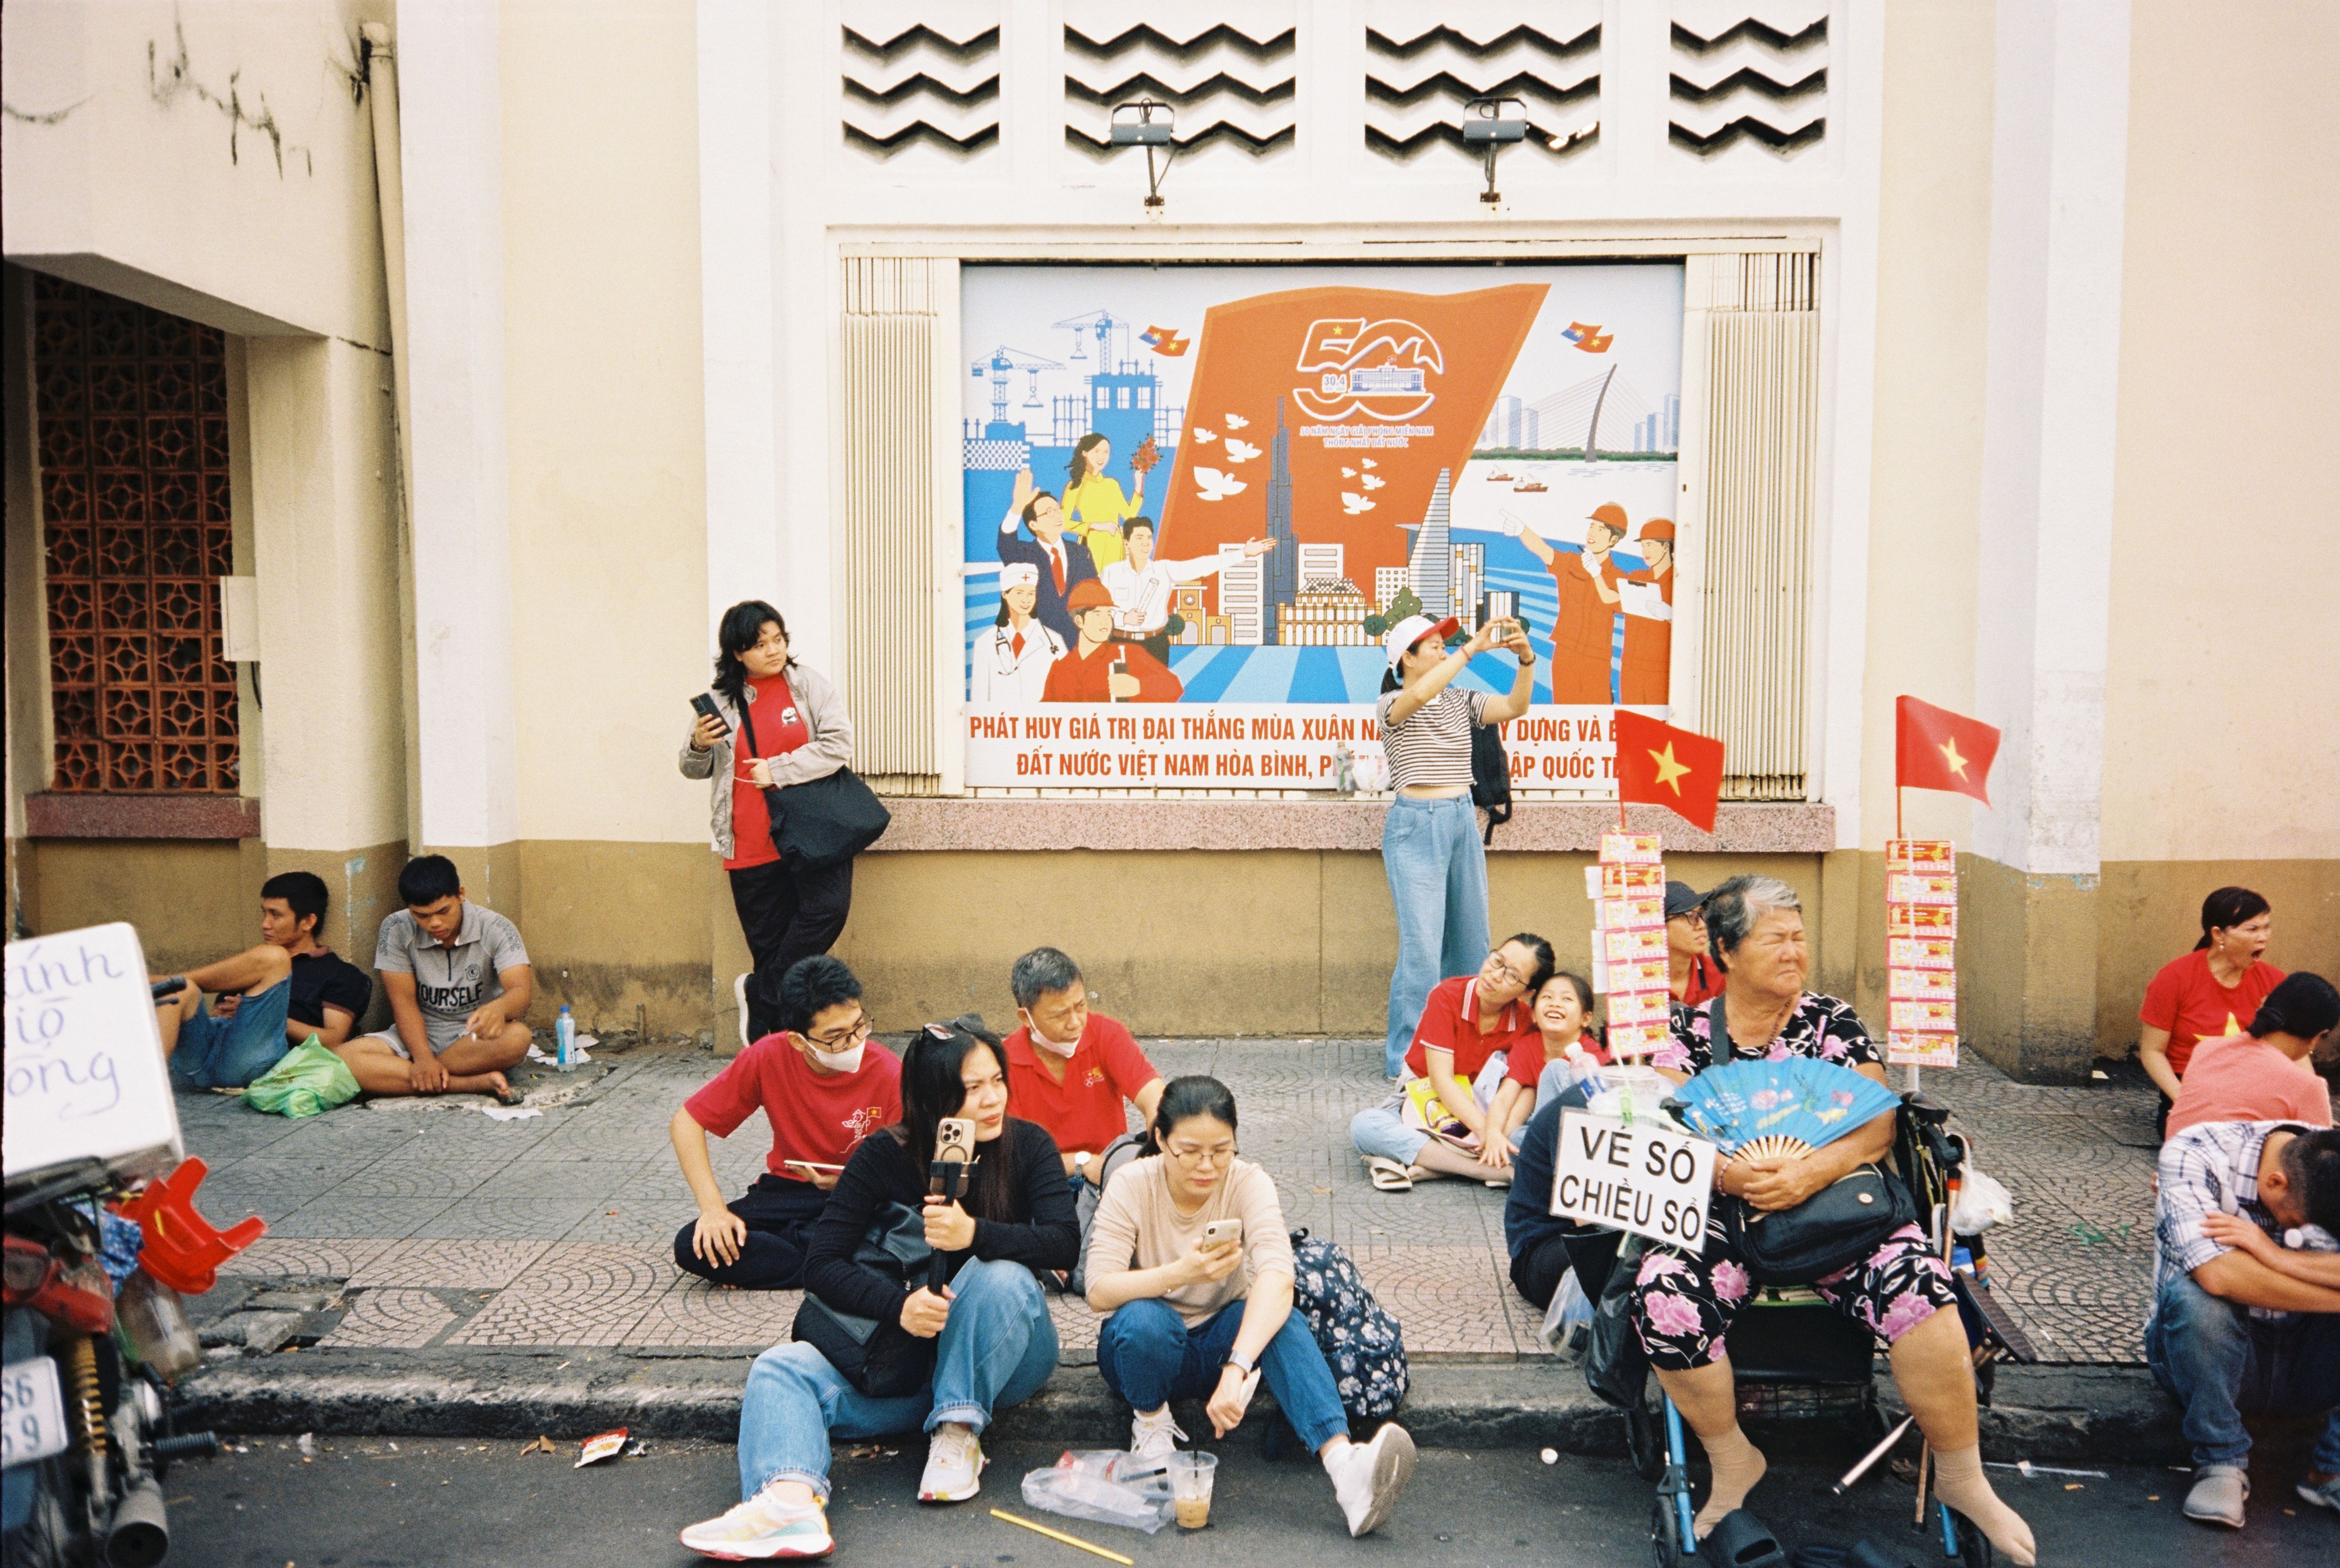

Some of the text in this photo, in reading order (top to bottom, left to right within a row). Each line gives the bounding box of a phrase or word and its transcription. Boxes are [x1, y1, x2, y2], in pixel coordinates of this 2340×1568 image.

[1323, 376, 1345, 386] 30.4
[1415, 426, 1433, 435] NAM
[970, 712, 1019, 738] PHÁT
[1026, 717, 1062, 739] HUY
[1069, 712, 1101, 739] GIÁ
[1107, 718, 1136, 744] TRỊ
[1143, 718, 1174, 744] ĐẠI
[1182, 709, 1244, 740] THẮNG
[1252, 713, 1295, 740] MÙA
[1302, 714, 1354, 740] XUÂN
[1517, 717, 1570, 746] DỰNG
[1577, 715, 1602, 742] VÀ
[1017, 745, 1053, 775] ĐẤT
[1060, 749, 1111, 776] NƯỚC
[1118, 749, 1158, 781] VIỆT
[1165, 754, 1209, 776] NAM
[1216, 749, 1254, 776] HÒA
[1261, 749, 1313, 779] BÌNH,
[1510, 751, 1536, 783] ẬP
[1543, 744, 1595, 780] QUỐC
[1645, 1141, 1695, 1184] SỐ
